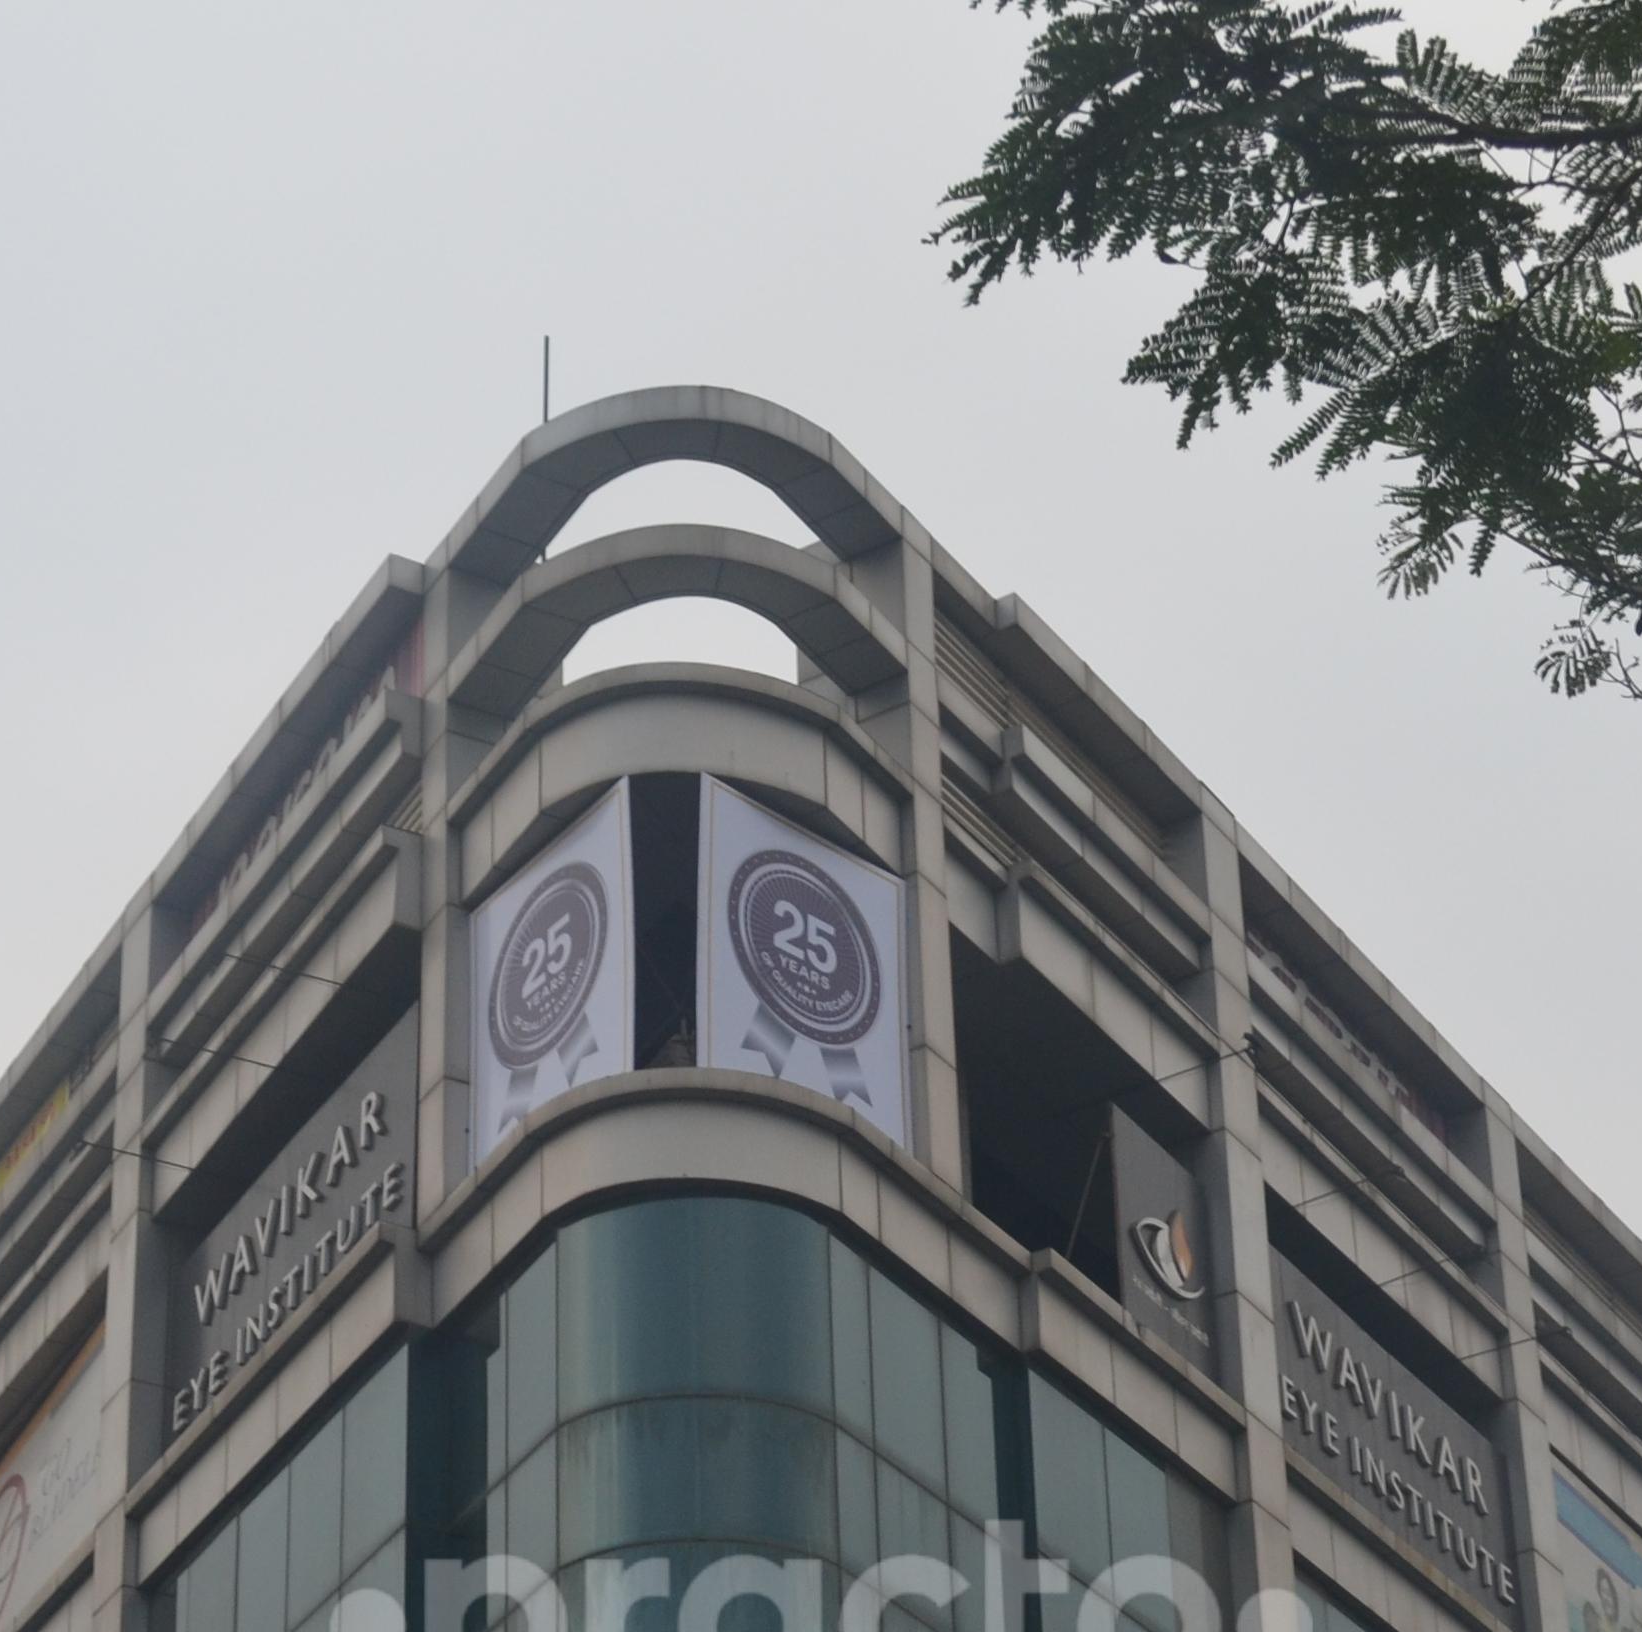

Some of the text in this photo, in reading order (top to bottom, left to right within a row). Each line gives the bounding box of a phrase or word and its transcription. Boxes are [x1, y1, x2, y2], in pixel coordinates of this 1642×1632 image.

[522, 912, 572, 999] 25
[773, 900, 837, 974] 25
[779, 954, 830, 990] YEARS
[172, 1162, 404, 1432] EYE INSTITUTE
[194, 1090, 385, 1326] WAVIKAR
[1280, 1373, 1516, 1605] EYE INSTITUTE
[1289, 1300, 1489, 1515] WAVIKAR
